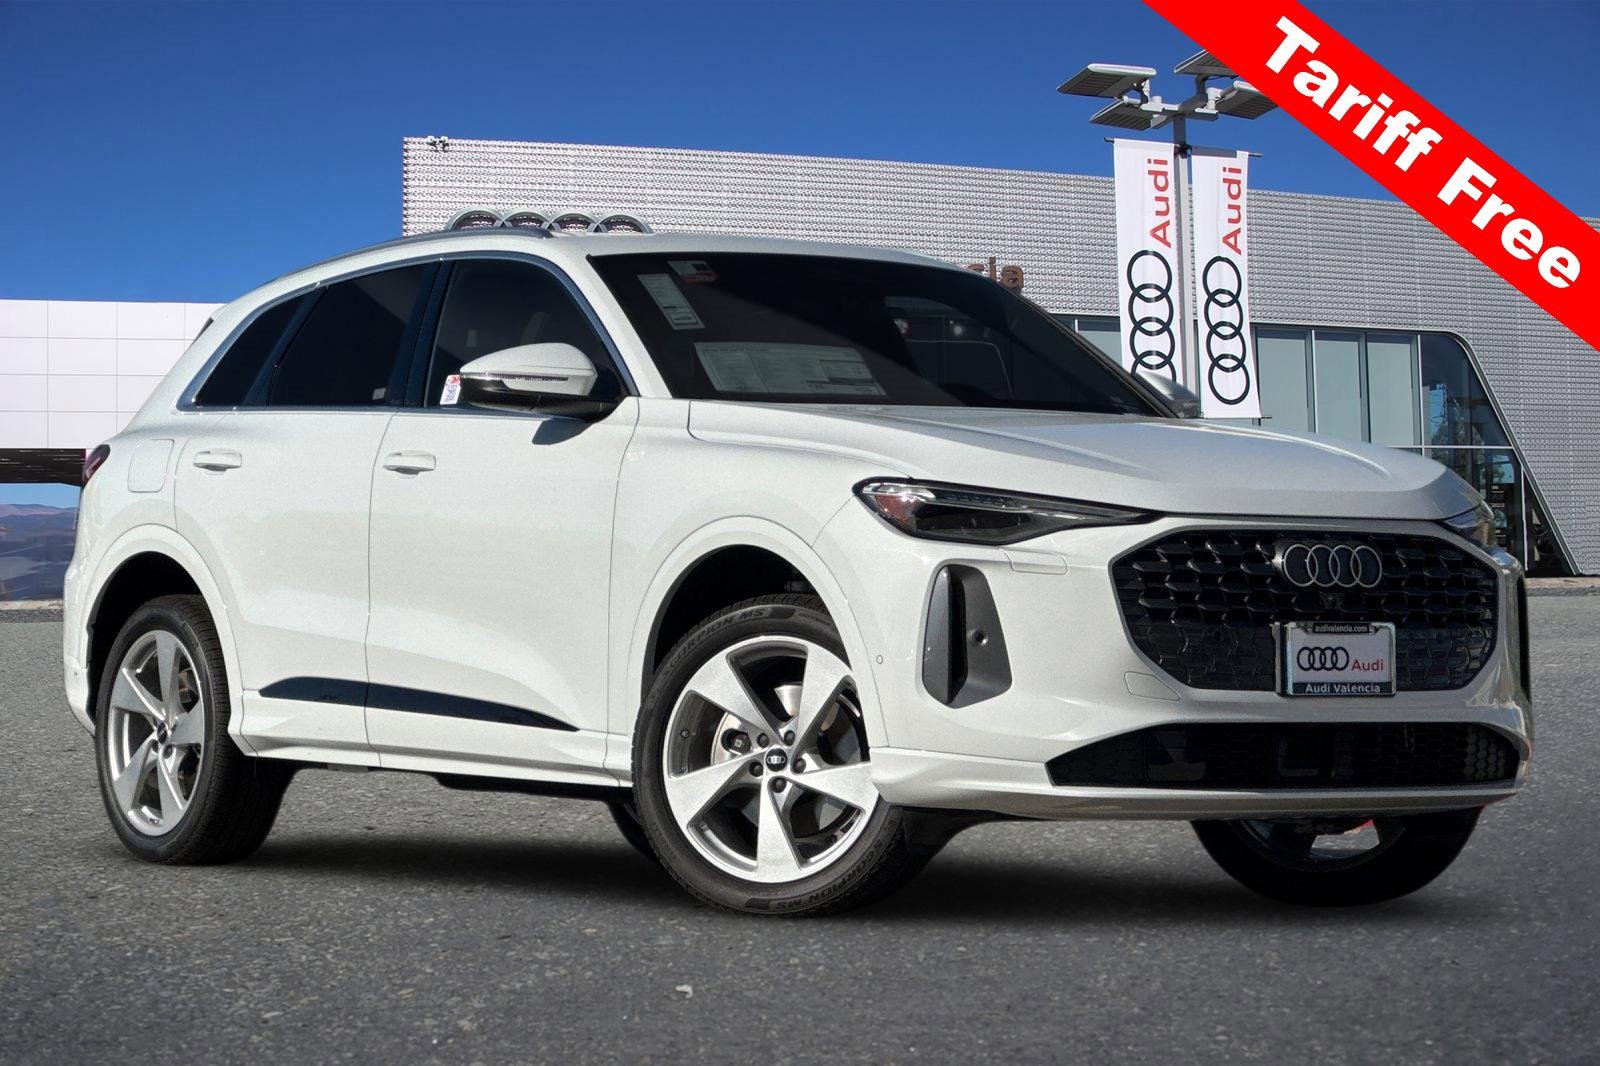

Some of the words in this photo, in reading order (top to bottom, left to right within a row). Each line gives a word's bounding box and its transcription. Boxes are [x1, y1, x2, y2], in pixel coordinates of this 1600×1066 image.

[1147, 158, 1171, 249] Audi
[1222, 166, 1242, 256] Audi
[1305, 684, 1331, 693] Audi
[1334, 684, 1380, 693] Valencia
[1351, 659, 1384, 671] Audi
